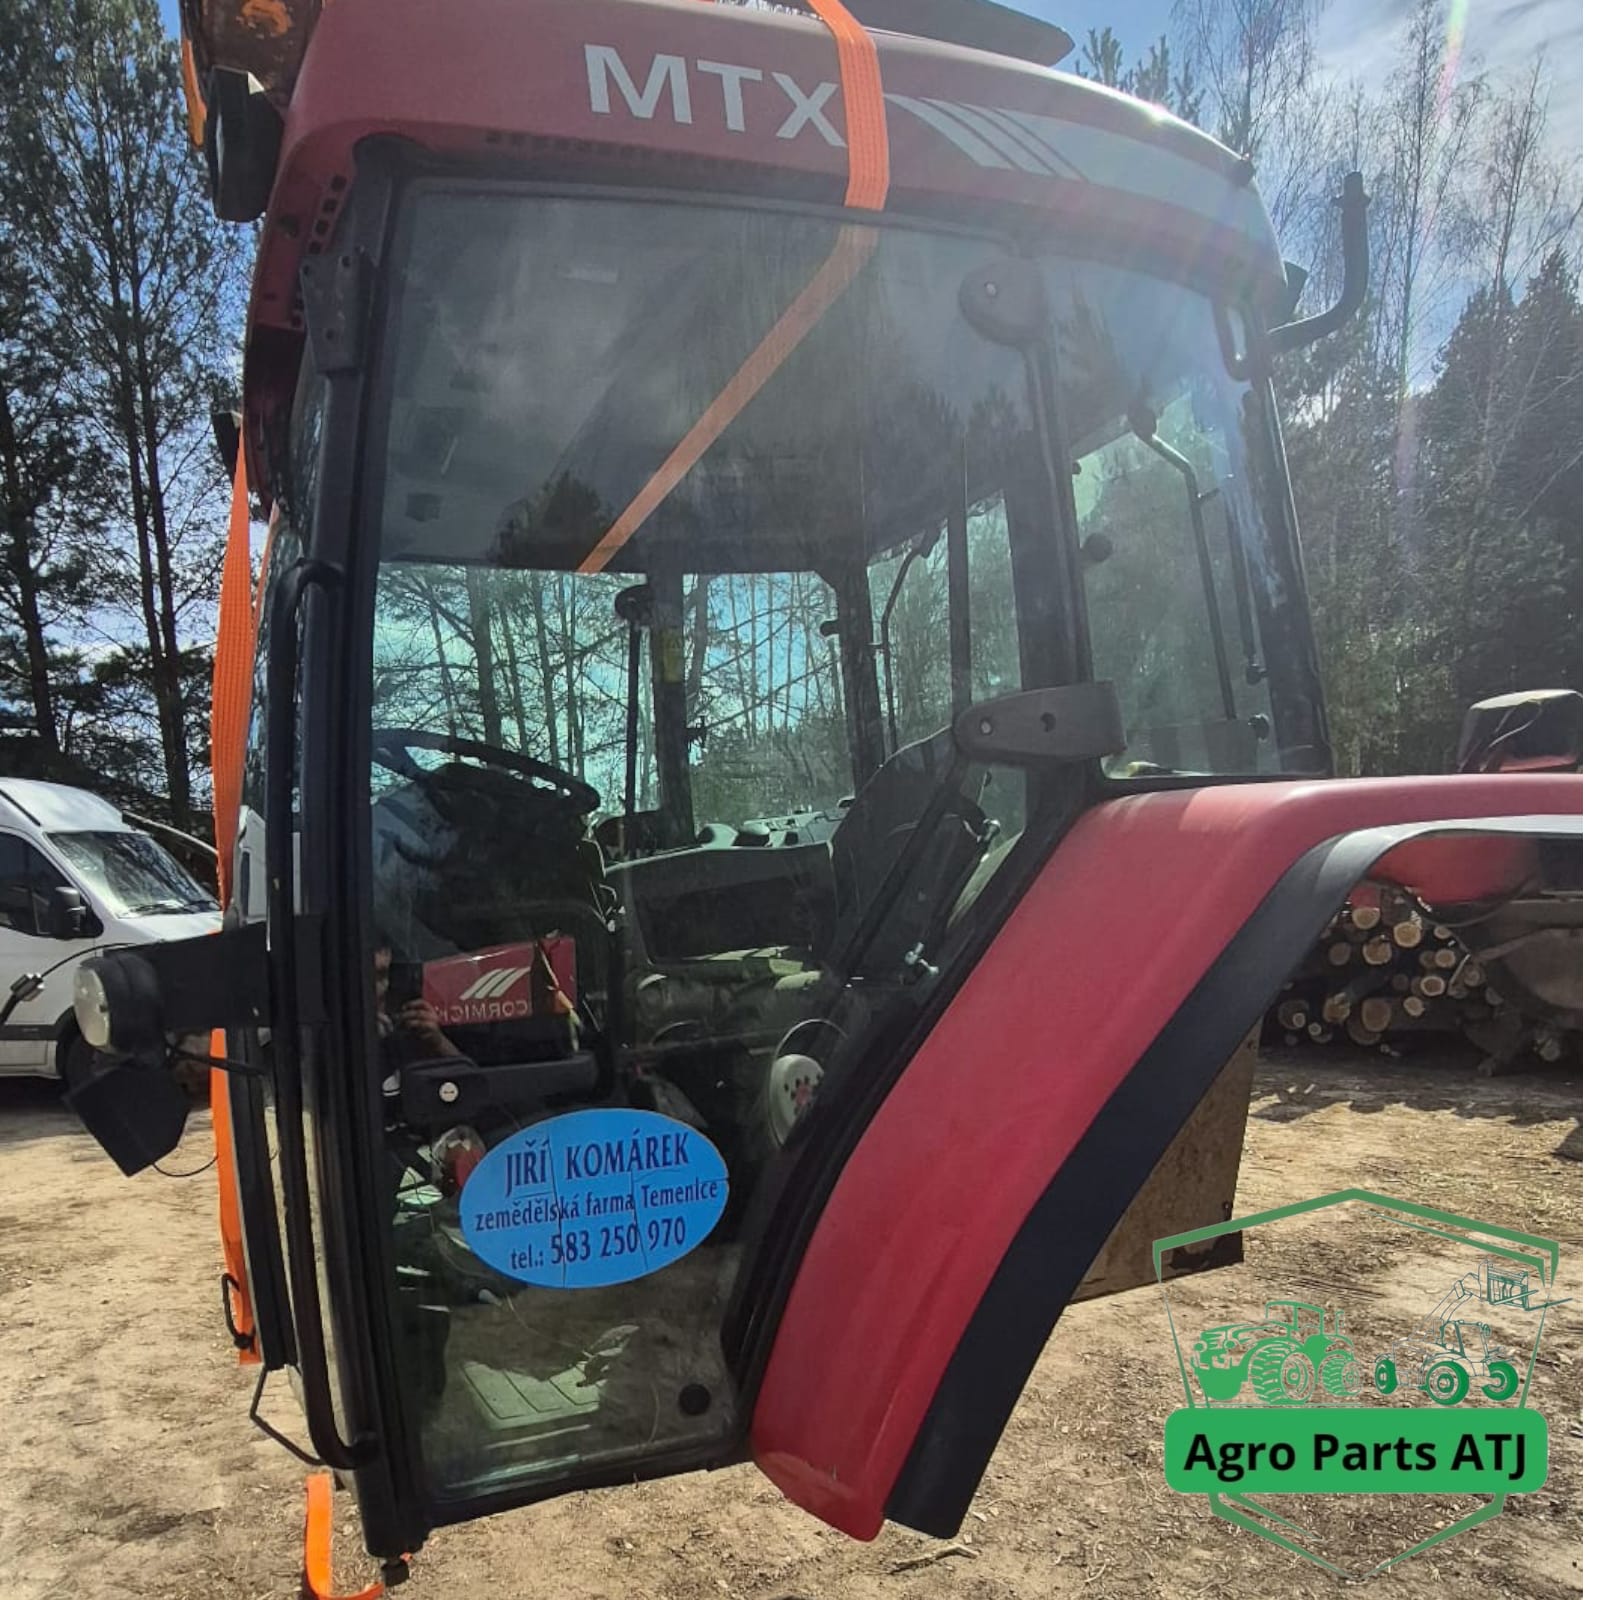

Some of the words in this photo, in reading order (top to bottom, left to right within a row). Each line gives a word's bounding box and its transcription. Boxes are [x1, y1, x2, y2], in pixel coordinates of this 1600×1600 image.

[584, 43, 848, 149] MTX
[505, 1138, 550, 1197] JIŘÍ
[565, 1128, 690, 1180] KOMÁREK
[475, 1199, 580, 1232] zemědělská
[585, 1191, 635, 1216] farma
[510, 1244, 544, 1270] tel.:
[550, 1230, 591, 1265] 583
[599, 1223, 638, 1258] 250
[648, 1216, 686, 1250] 970
